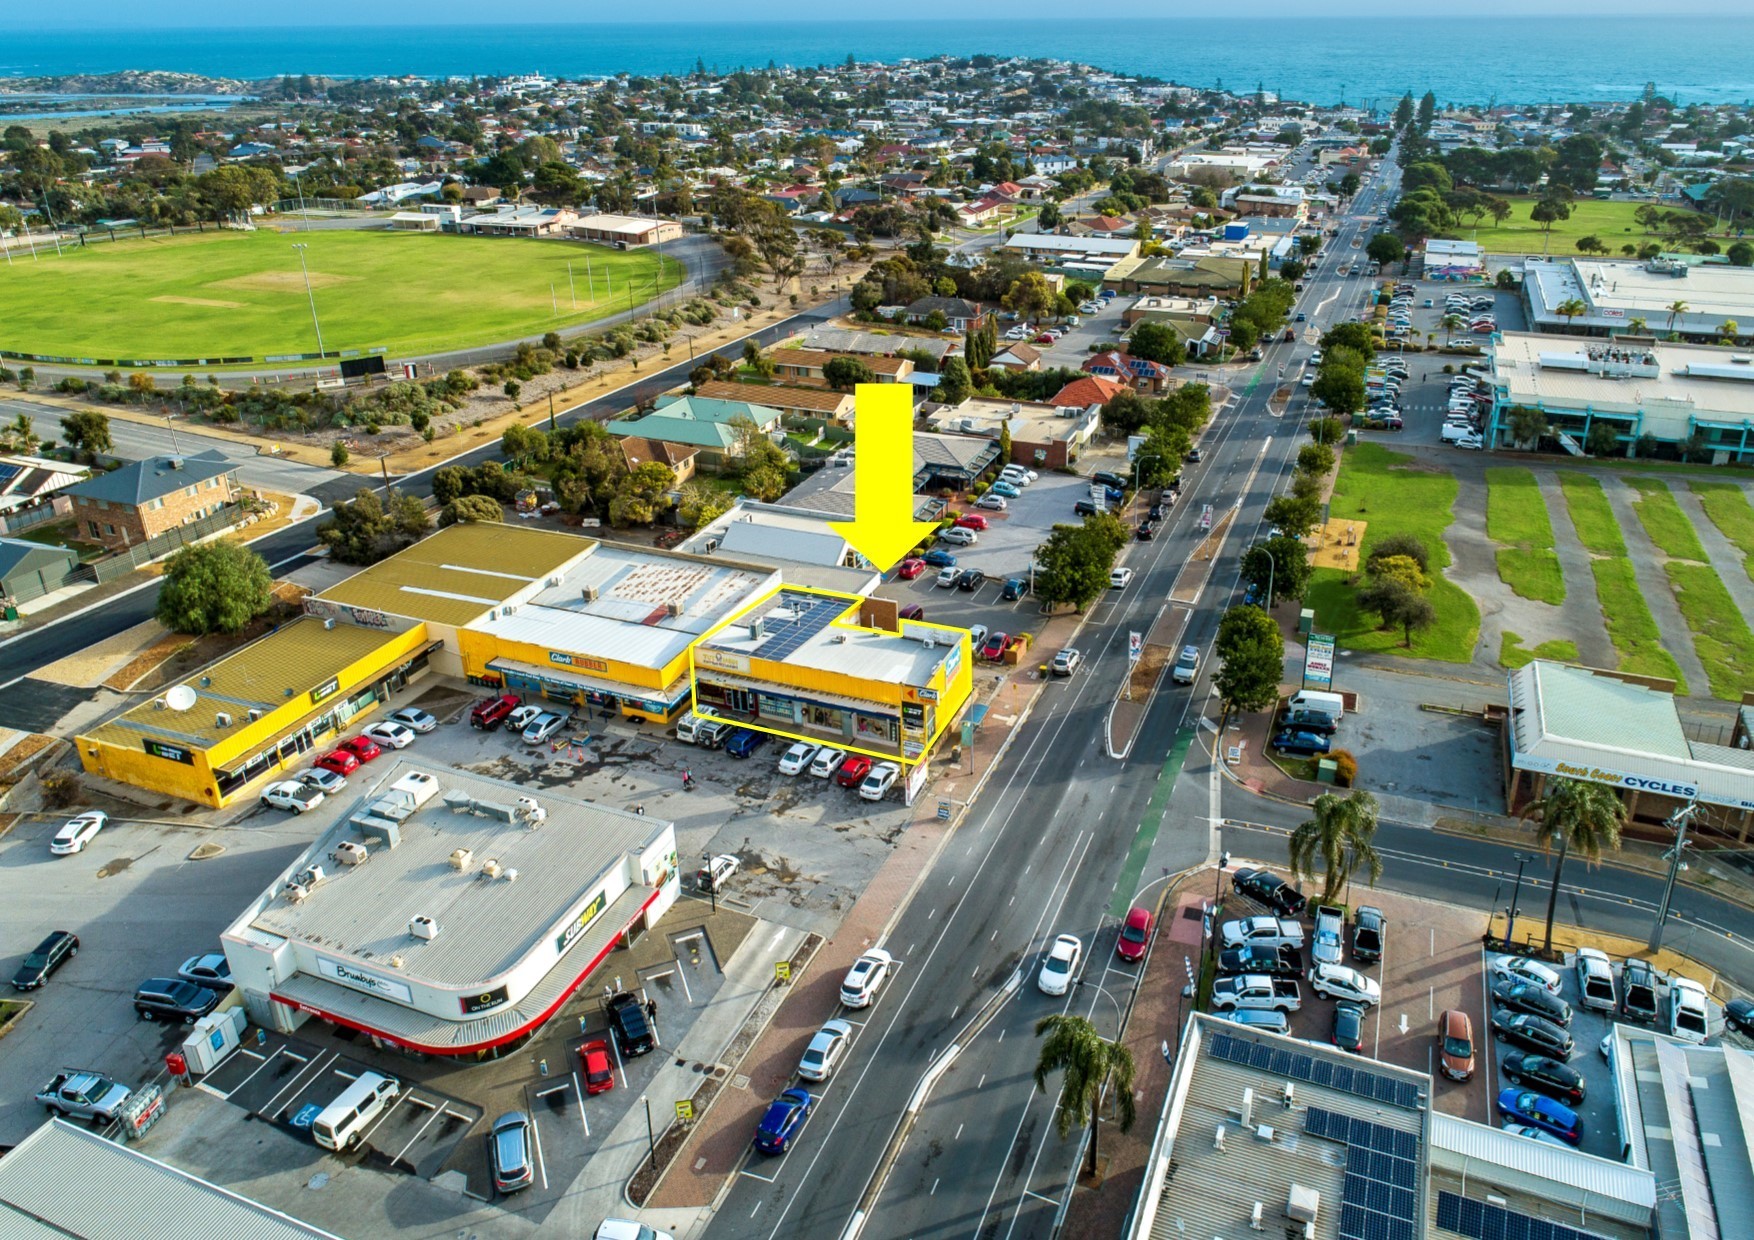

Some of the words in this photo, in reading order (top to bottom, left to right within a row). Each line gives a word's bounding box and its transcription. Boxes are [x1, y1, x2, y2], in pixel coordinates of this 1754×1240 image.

[551, 653, 571, 664] Clark
[574, 657, 602, 670] RUBBER
[1555, 762, 1588, 778] South
[1590, 768, 1623, 783] Coast
[1624, 776, 1695, 796] CYCLES
[563, 896, 601, 946] SUBWAY
[481, 1002, 491, 1010] THE
[491, 998, 503, 1006] RUN
